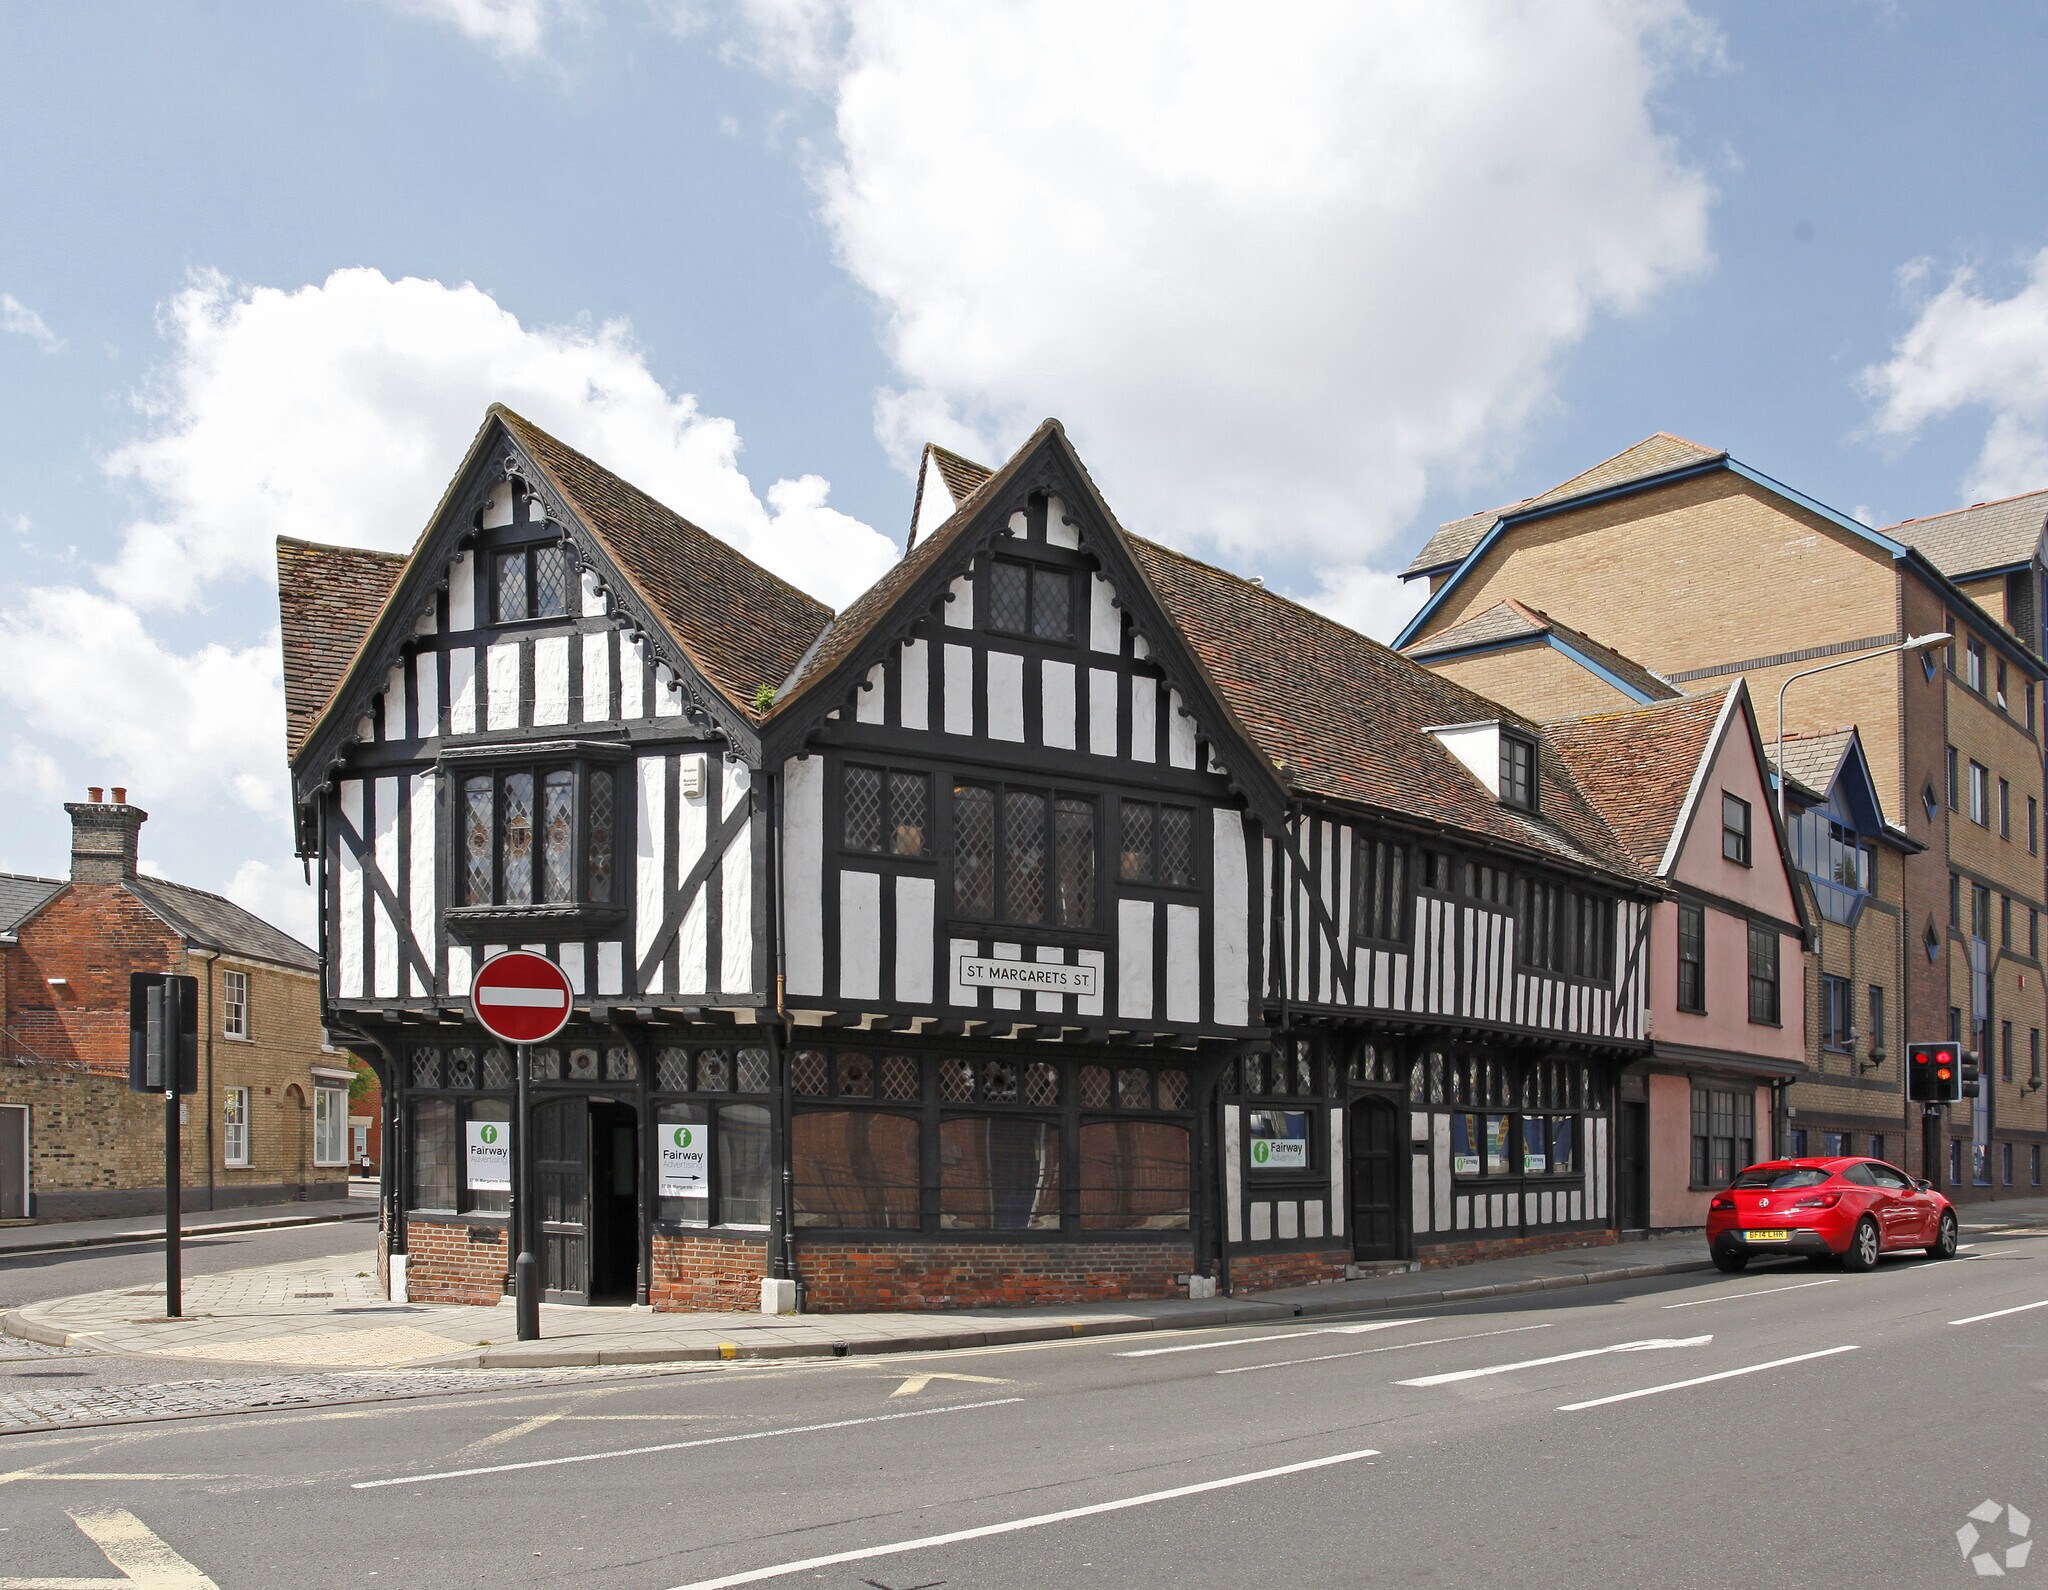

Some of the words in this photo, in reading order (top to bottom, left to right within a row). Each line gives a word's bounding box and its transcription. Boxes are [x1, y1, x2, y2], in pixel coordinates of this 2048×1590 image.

[967, 965, 984, 978] ST.
[989, 966, 1067, 985] MARGARETS
[1073, 974, 1089, 987] ST.
[165, 1090, 173, 1100] 5
[485, 1126, 492, 1142] f
[679, 1129, 686, 1146] f
[470, 1145, 508, 1158] Fairway
[1270, 1142, 1303, 1155] Fairway
[470, 1156, 508, 1165] Advertising
[663, 1149, 703, 1163] Fairway
[662, 1160, 703, 1171] Advertising
